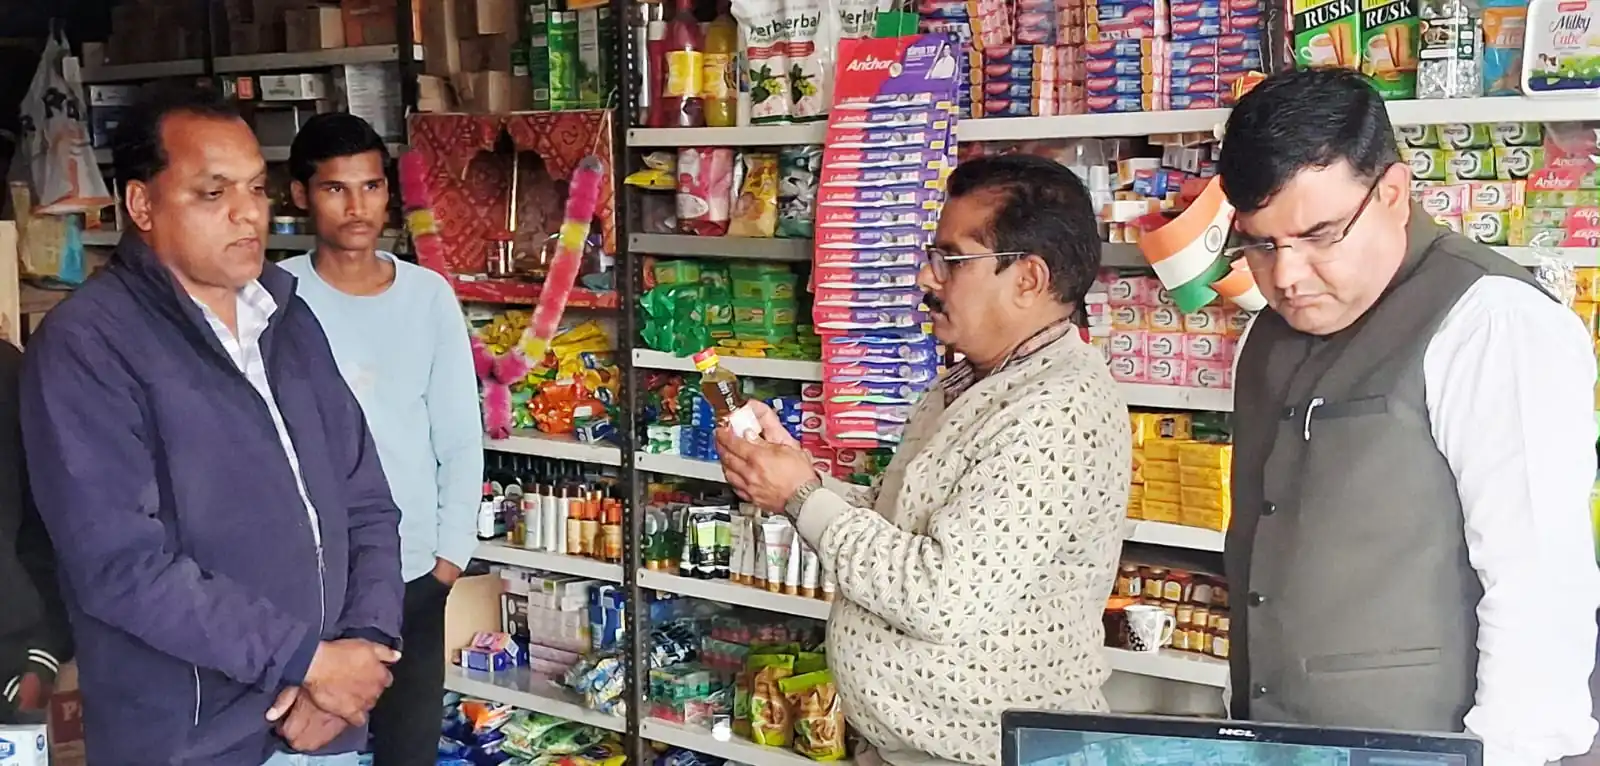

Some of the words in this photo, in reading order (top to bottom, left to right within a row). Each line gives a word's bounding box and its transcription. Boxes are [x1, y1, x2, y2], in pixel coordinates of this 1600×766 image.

[1304, 0, 1353, 29] RUSK
[1365, 0, 1411, 29] RUSK
[1549, 13, 1591, 34] Milky
[846, 57, 893, 71] Anchor
[1534, 175, 1574, 188] Anchor
[1218, 728, 1255, 737] HCL
